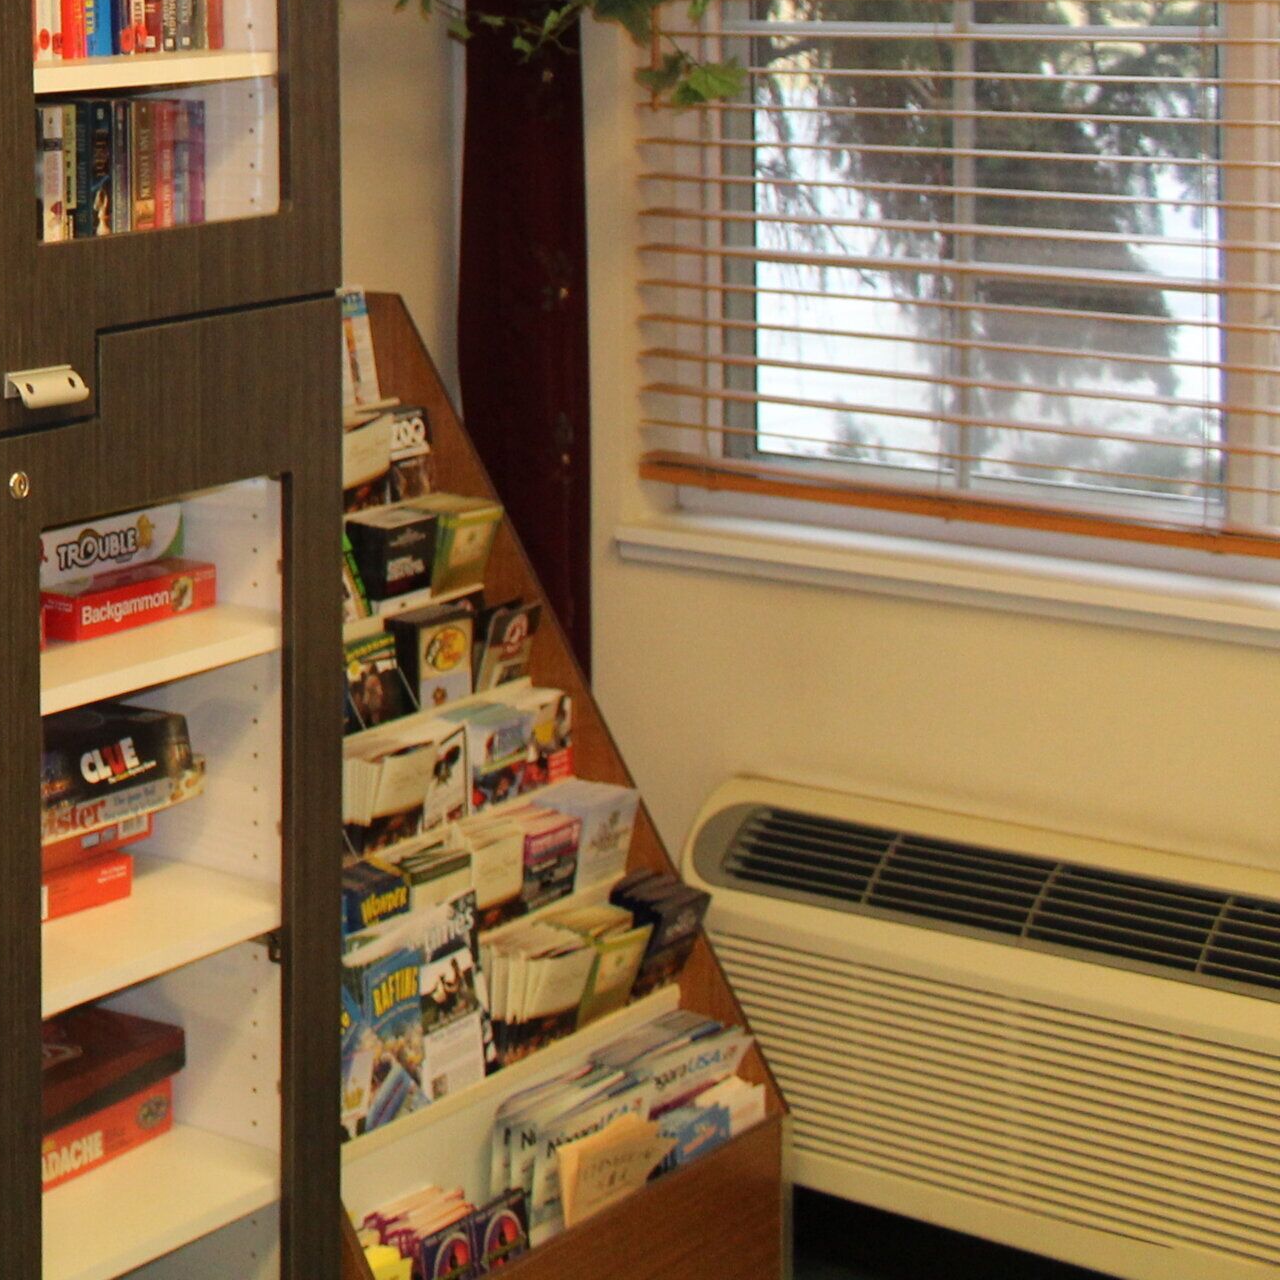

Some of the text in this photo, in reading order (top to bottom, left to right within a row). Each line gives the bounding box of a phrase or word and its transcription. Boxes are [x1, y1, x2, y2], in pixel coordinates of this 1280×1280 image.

[56, 528, 139, 571] TROUBLE
[81, 590, 170, 626] Backgammon
[80, 736, 140, 784] CLUE
